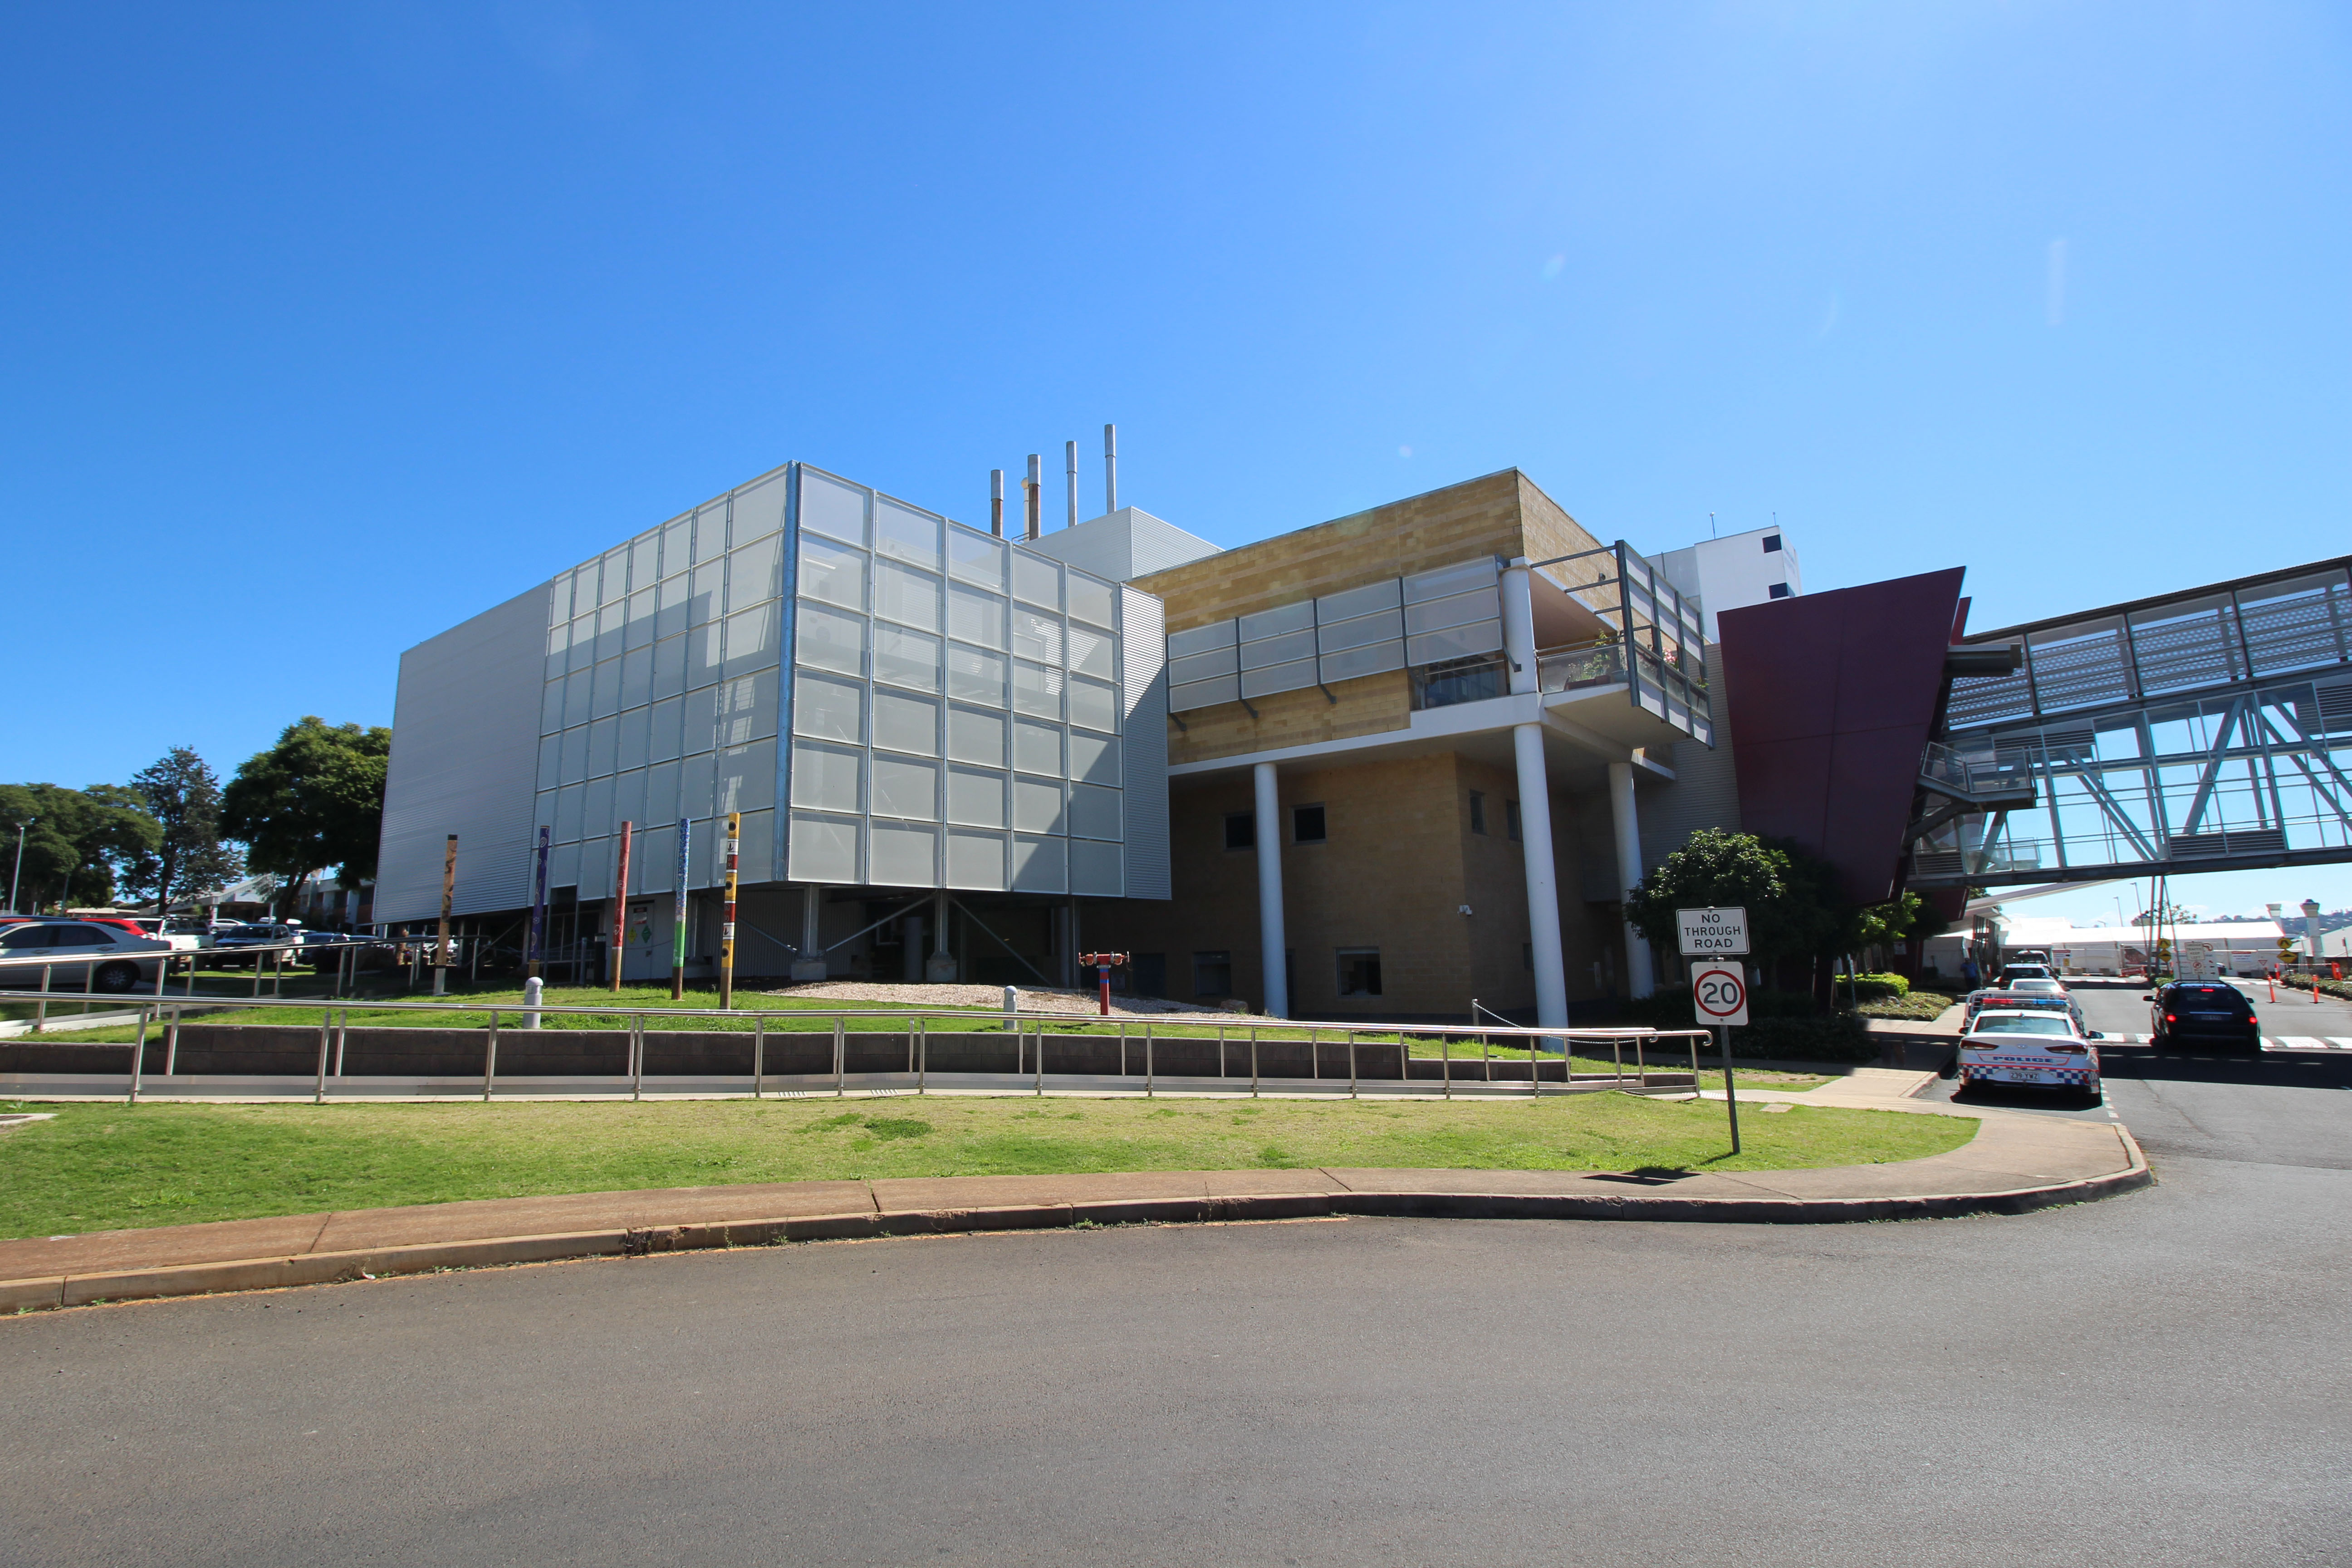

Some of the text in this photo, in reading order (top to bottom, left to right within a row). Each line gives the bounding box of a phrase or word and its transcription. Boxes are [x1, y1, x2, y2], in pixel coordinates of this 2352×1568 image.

[1701, 914, 1720, 923] NO
[1685, 926, 1741, 936] THROUGH
[1694, 938, 1733, 948] ROAD
[1702, 982, 1738, 1004] 20
